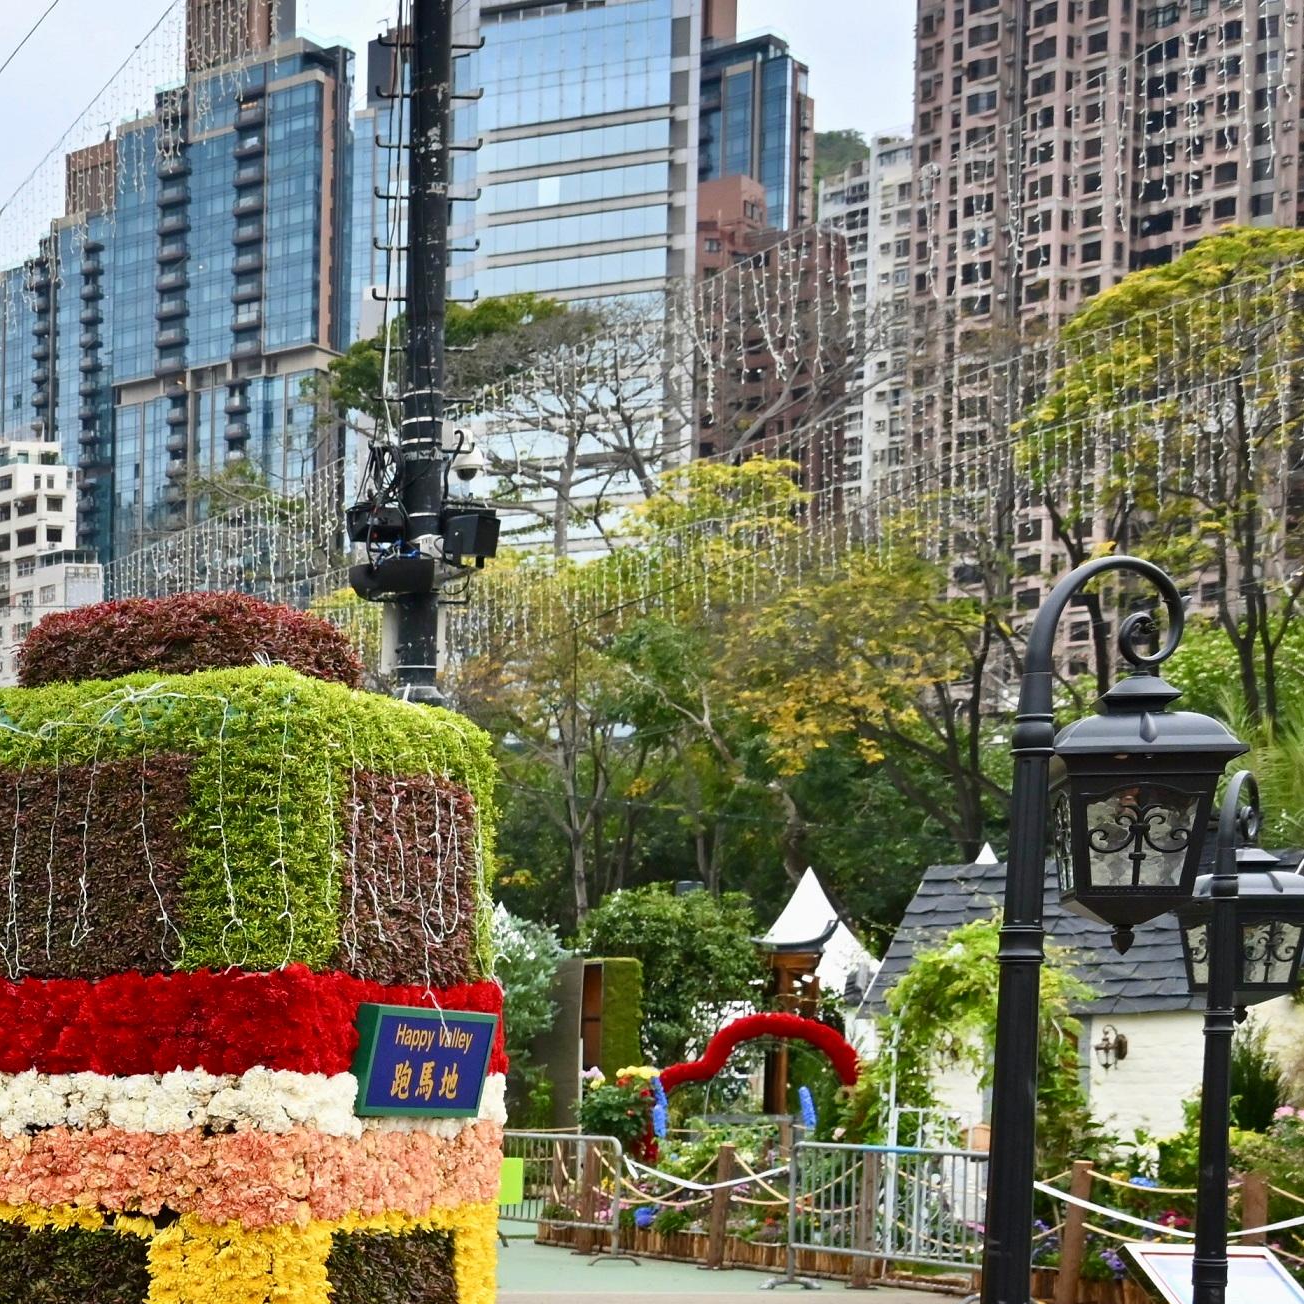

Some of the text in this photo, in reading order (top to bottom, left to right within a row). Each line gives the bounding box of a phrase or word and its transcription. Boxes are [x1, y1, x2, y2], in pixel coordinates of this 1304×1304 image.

[395, 1023, 474, 1055] Happy Valley
[390, 1060, 459, 1101] 跑馬地
